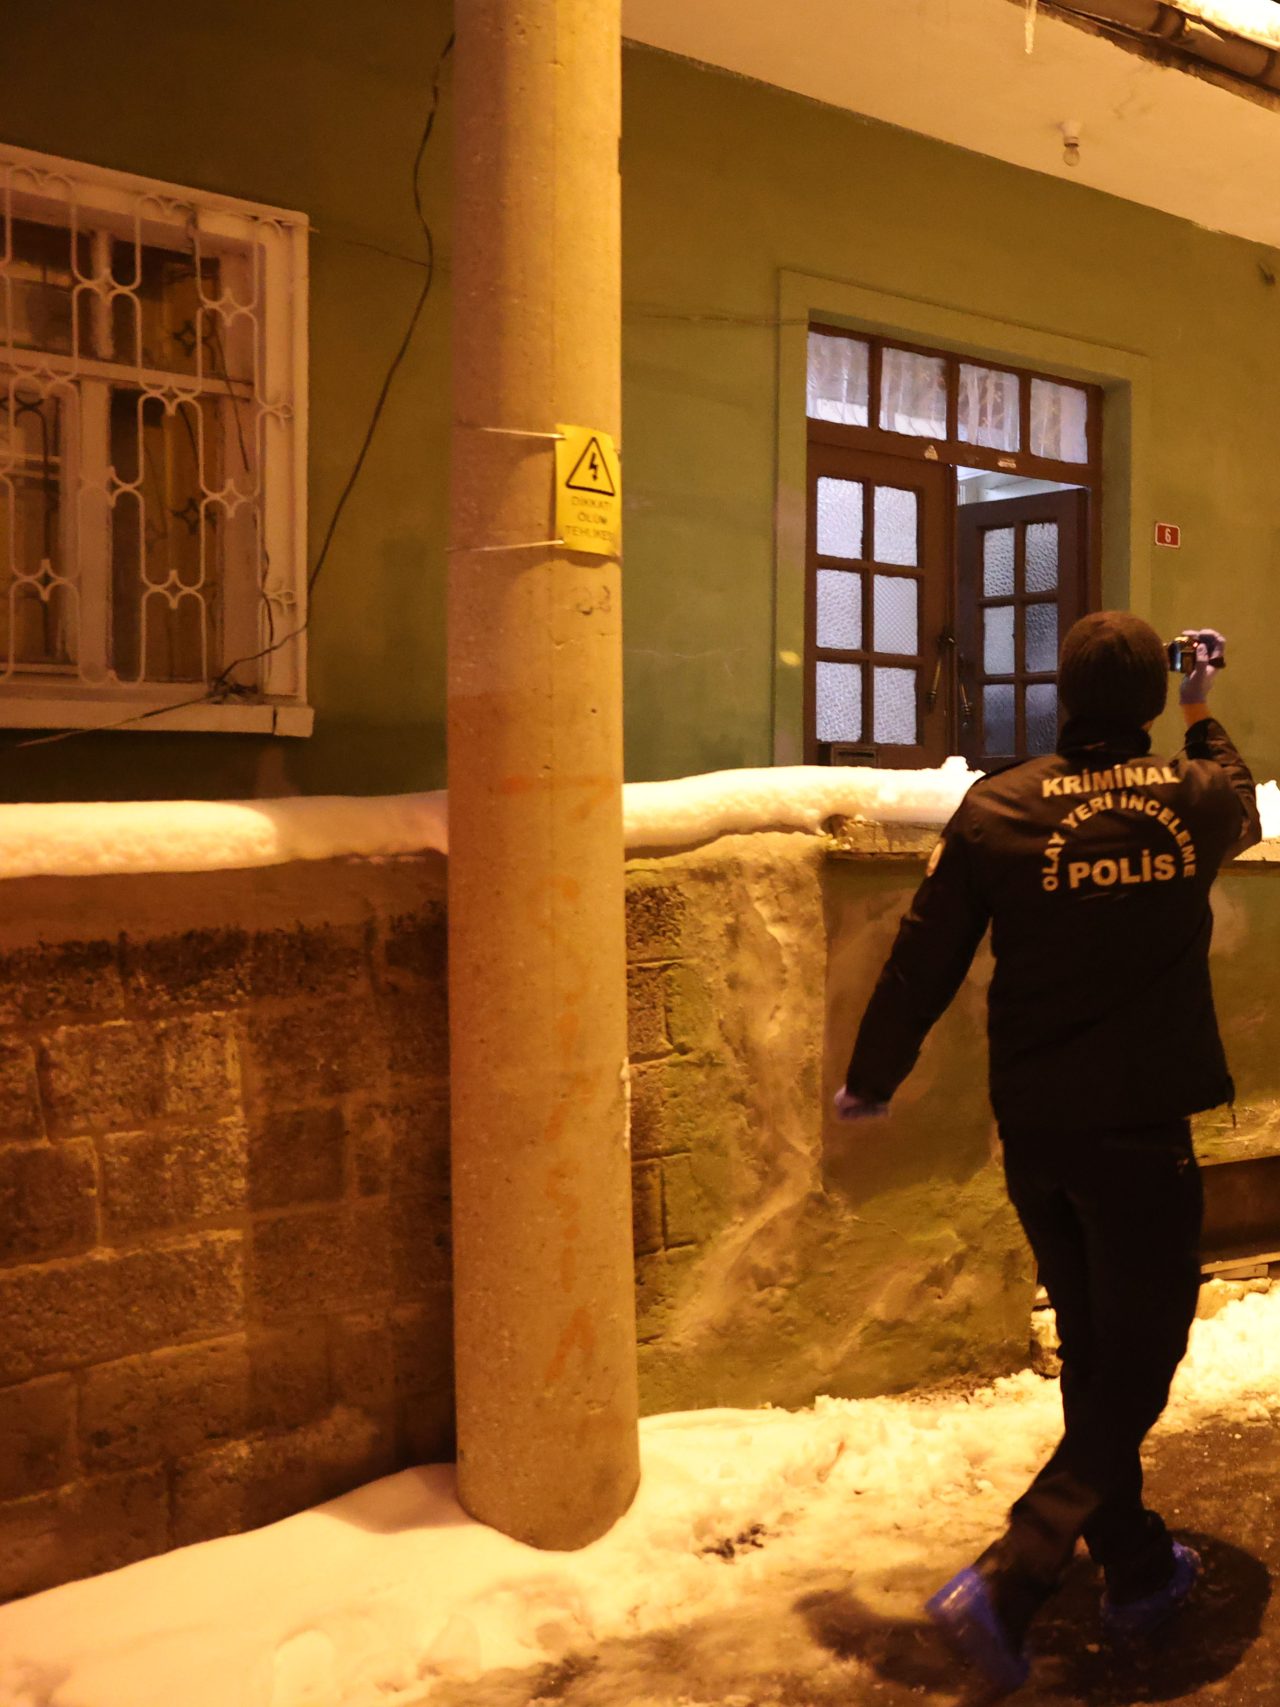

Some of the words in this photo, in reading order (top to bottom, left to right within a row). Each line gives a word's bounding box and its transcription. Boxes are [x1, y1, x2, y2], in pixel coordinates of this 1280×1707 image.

[1165, 527, 1172, 543] 6
[1042, 764, 1182, 798] KRİMİNAL
[1042, 832, 1067, 891] OLAY
[1061, 792, 1114, 829] YERİ
[1120, 791, 1197, 878] İNCELEME
[1068, 849, 1177, 889] POLİS
